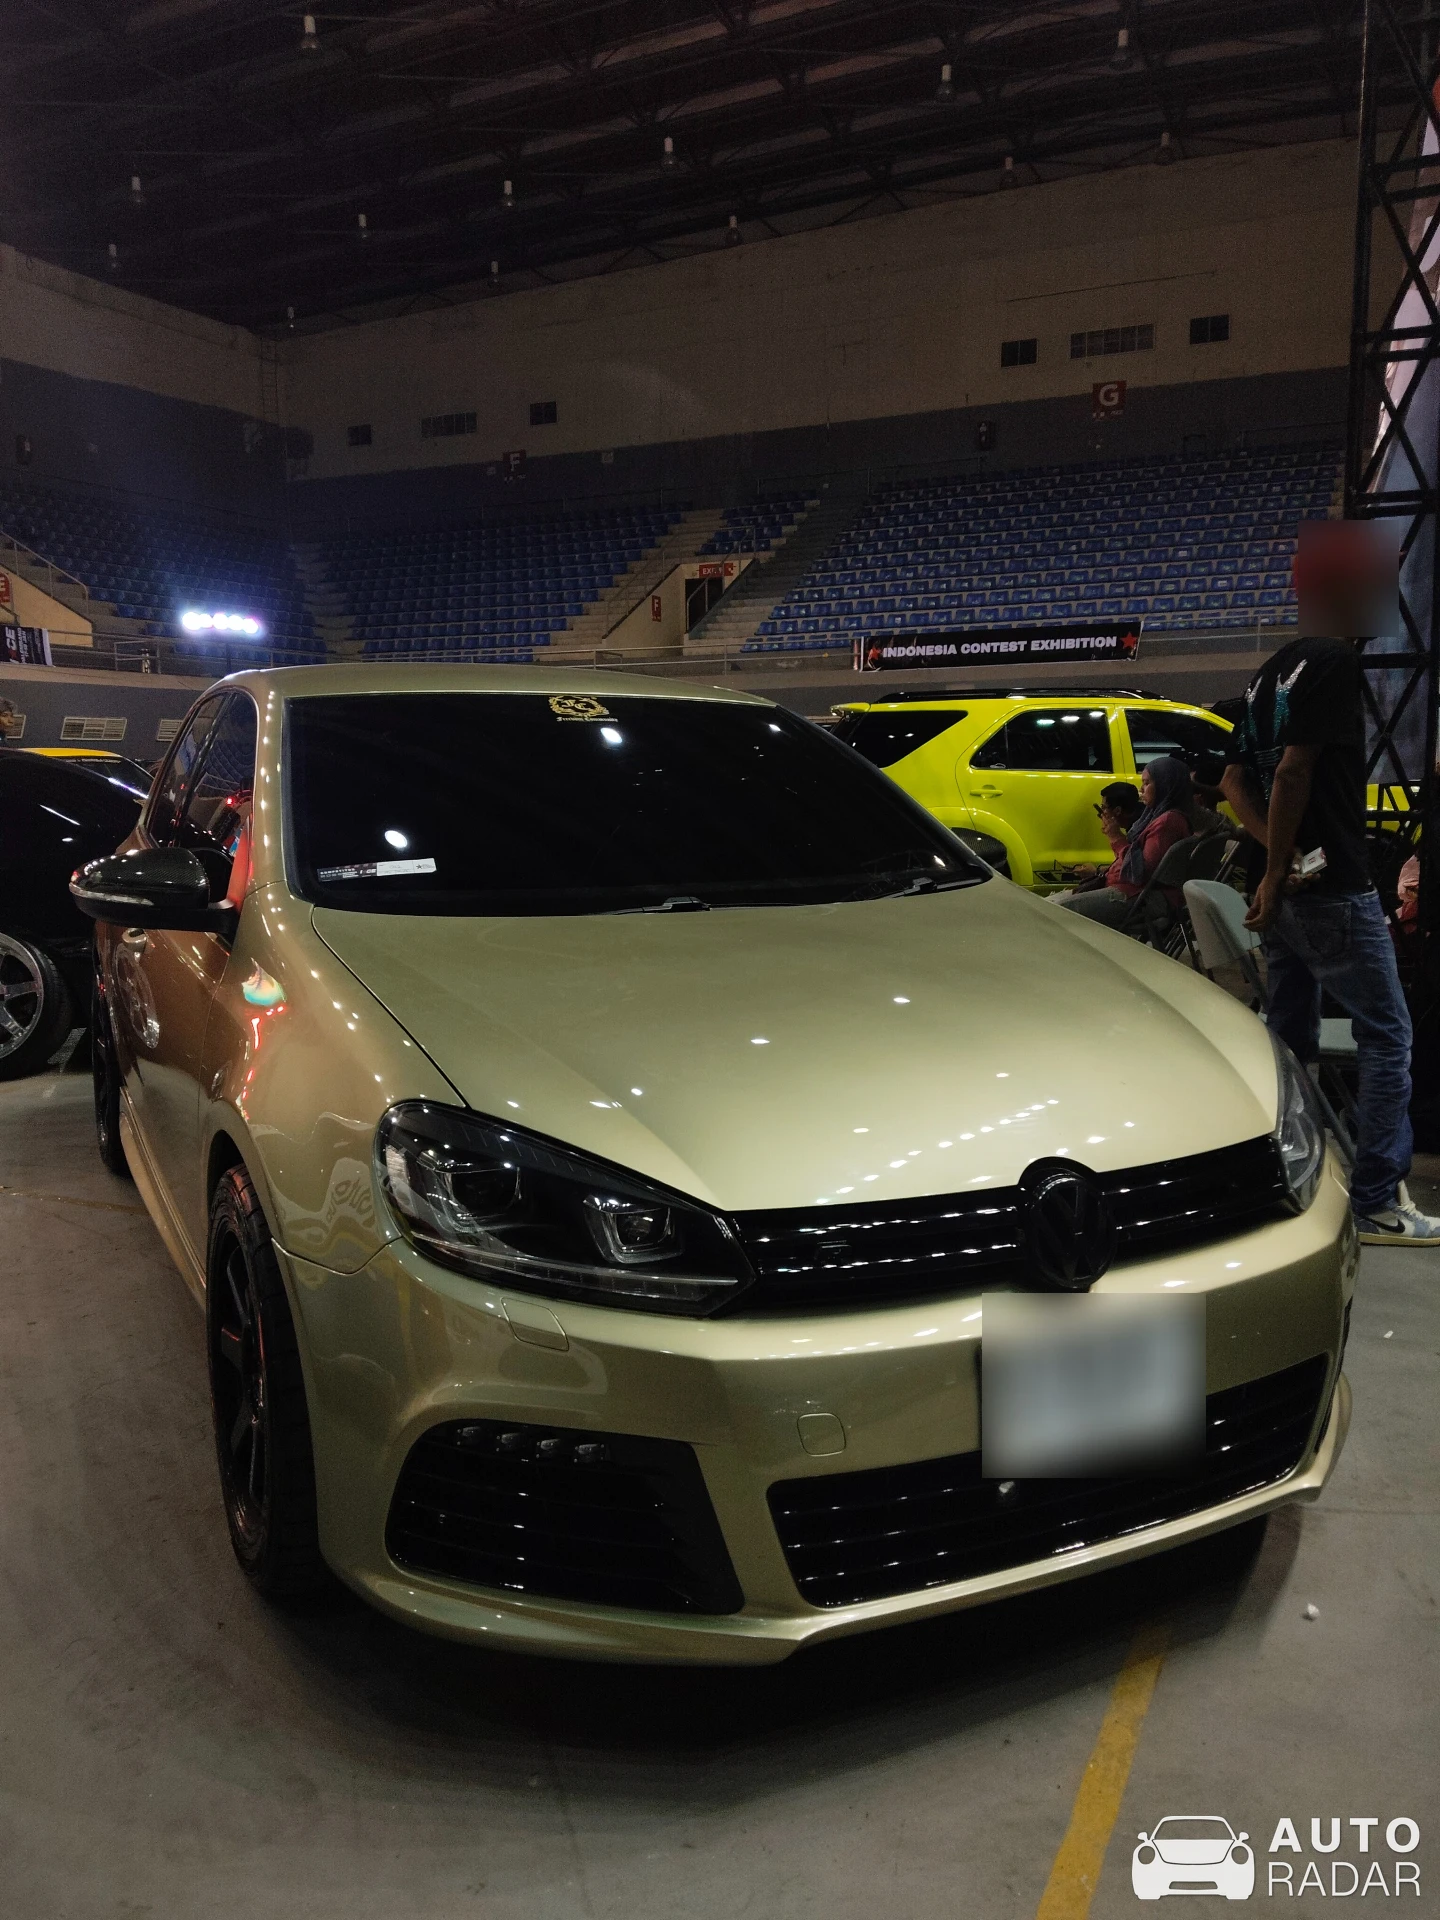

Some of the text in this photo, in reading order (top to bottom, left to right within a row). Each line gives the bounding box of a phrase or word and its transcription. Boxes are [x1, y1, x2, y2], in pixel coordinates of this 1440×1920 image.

[1099, 384, 1119, 406] G
[509, 453, 520, 471] F
[654, 599, 659, 611] F
[882, 636, 1117, 658] INDONESIA CONTEST EXHIBITION
